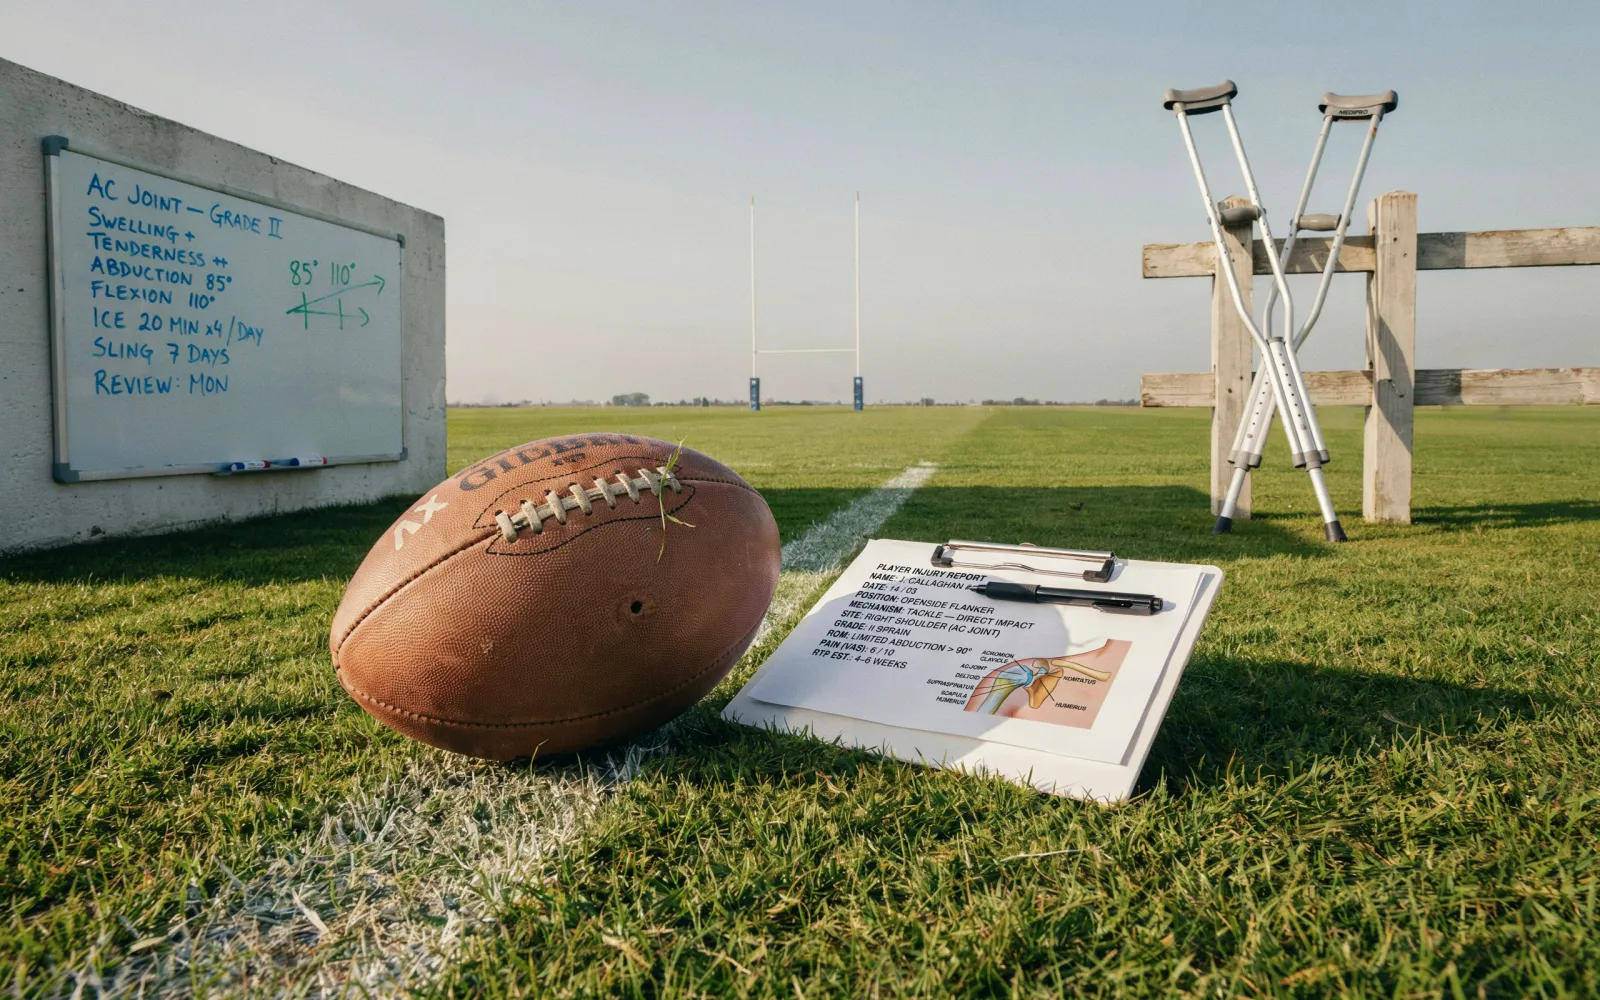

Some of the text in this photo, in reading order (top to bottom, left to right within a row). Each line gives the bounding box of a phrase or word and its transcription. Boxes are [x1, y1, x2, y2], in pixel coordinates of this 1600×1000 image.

[87, 173, 119, 201] AC
[127, 184, 182, 214] JOINT
[210, 204, 261, 234] GRADE
[268, 216, 283, 239] II
[88, 206, 180, 244] SWELLING
[87, 232, 206, 267] TENDERNESS
[91, 255, 232, 292] ABDUCTION 85°
[91, 280, 215, 309] FLEXION 110°
[93, 307, 126, 329] ICE
[138, 312, 162, 332] 20
[170, 316, 199, 336] MIN
[92, 336, 230, 368] SLING 7 DAYS
[94, 369, 229, 396] REVIEW: MON
[869, 572, 898, 582] NAME:
[908, 577, 965, 590] CALLAGHAN
[876, 563, 988, 582] PLAYER INJURY REPORT
[862, 581, 888, 591] DATE:
[905, 587, 918, 595] 03
[855, 590, 995, 614] POSITION: OPENSIDE FLANKER
[841, 609, 1001, 638] SITE: RIGHT SHOULDER (AC JOINT)
[848, 600, 906, 614] MECHANISM:
[906, 607, 944, 619] TACKLE
[956, 613, 995, 625] DIRECT
[994, 619, 1036, 630] IMPACT
[833, 619, 867, 630] GRADE:
[875, 625, 912, 636] SPRAIN
[819, 639, 842, 648] PAIN
[840, 642, 868, 653] (VAS):
[869, 646, 878, 654] 6
[884, 648, 896, 656] 10
[826, 629, 851, 639] ROM:
[851, 633, 889, 644] LIMITED
[888, 638, 947, 652] ABDUCTION
[811, 648, 831, 658] RTP
[872, 657, 908, 669] WEEKS
[981, 650, 1015, 659] ACROMION
[941, 690, 968, 699] SCAPULA
[1055, 702, 1087, 711] HUMERUS
